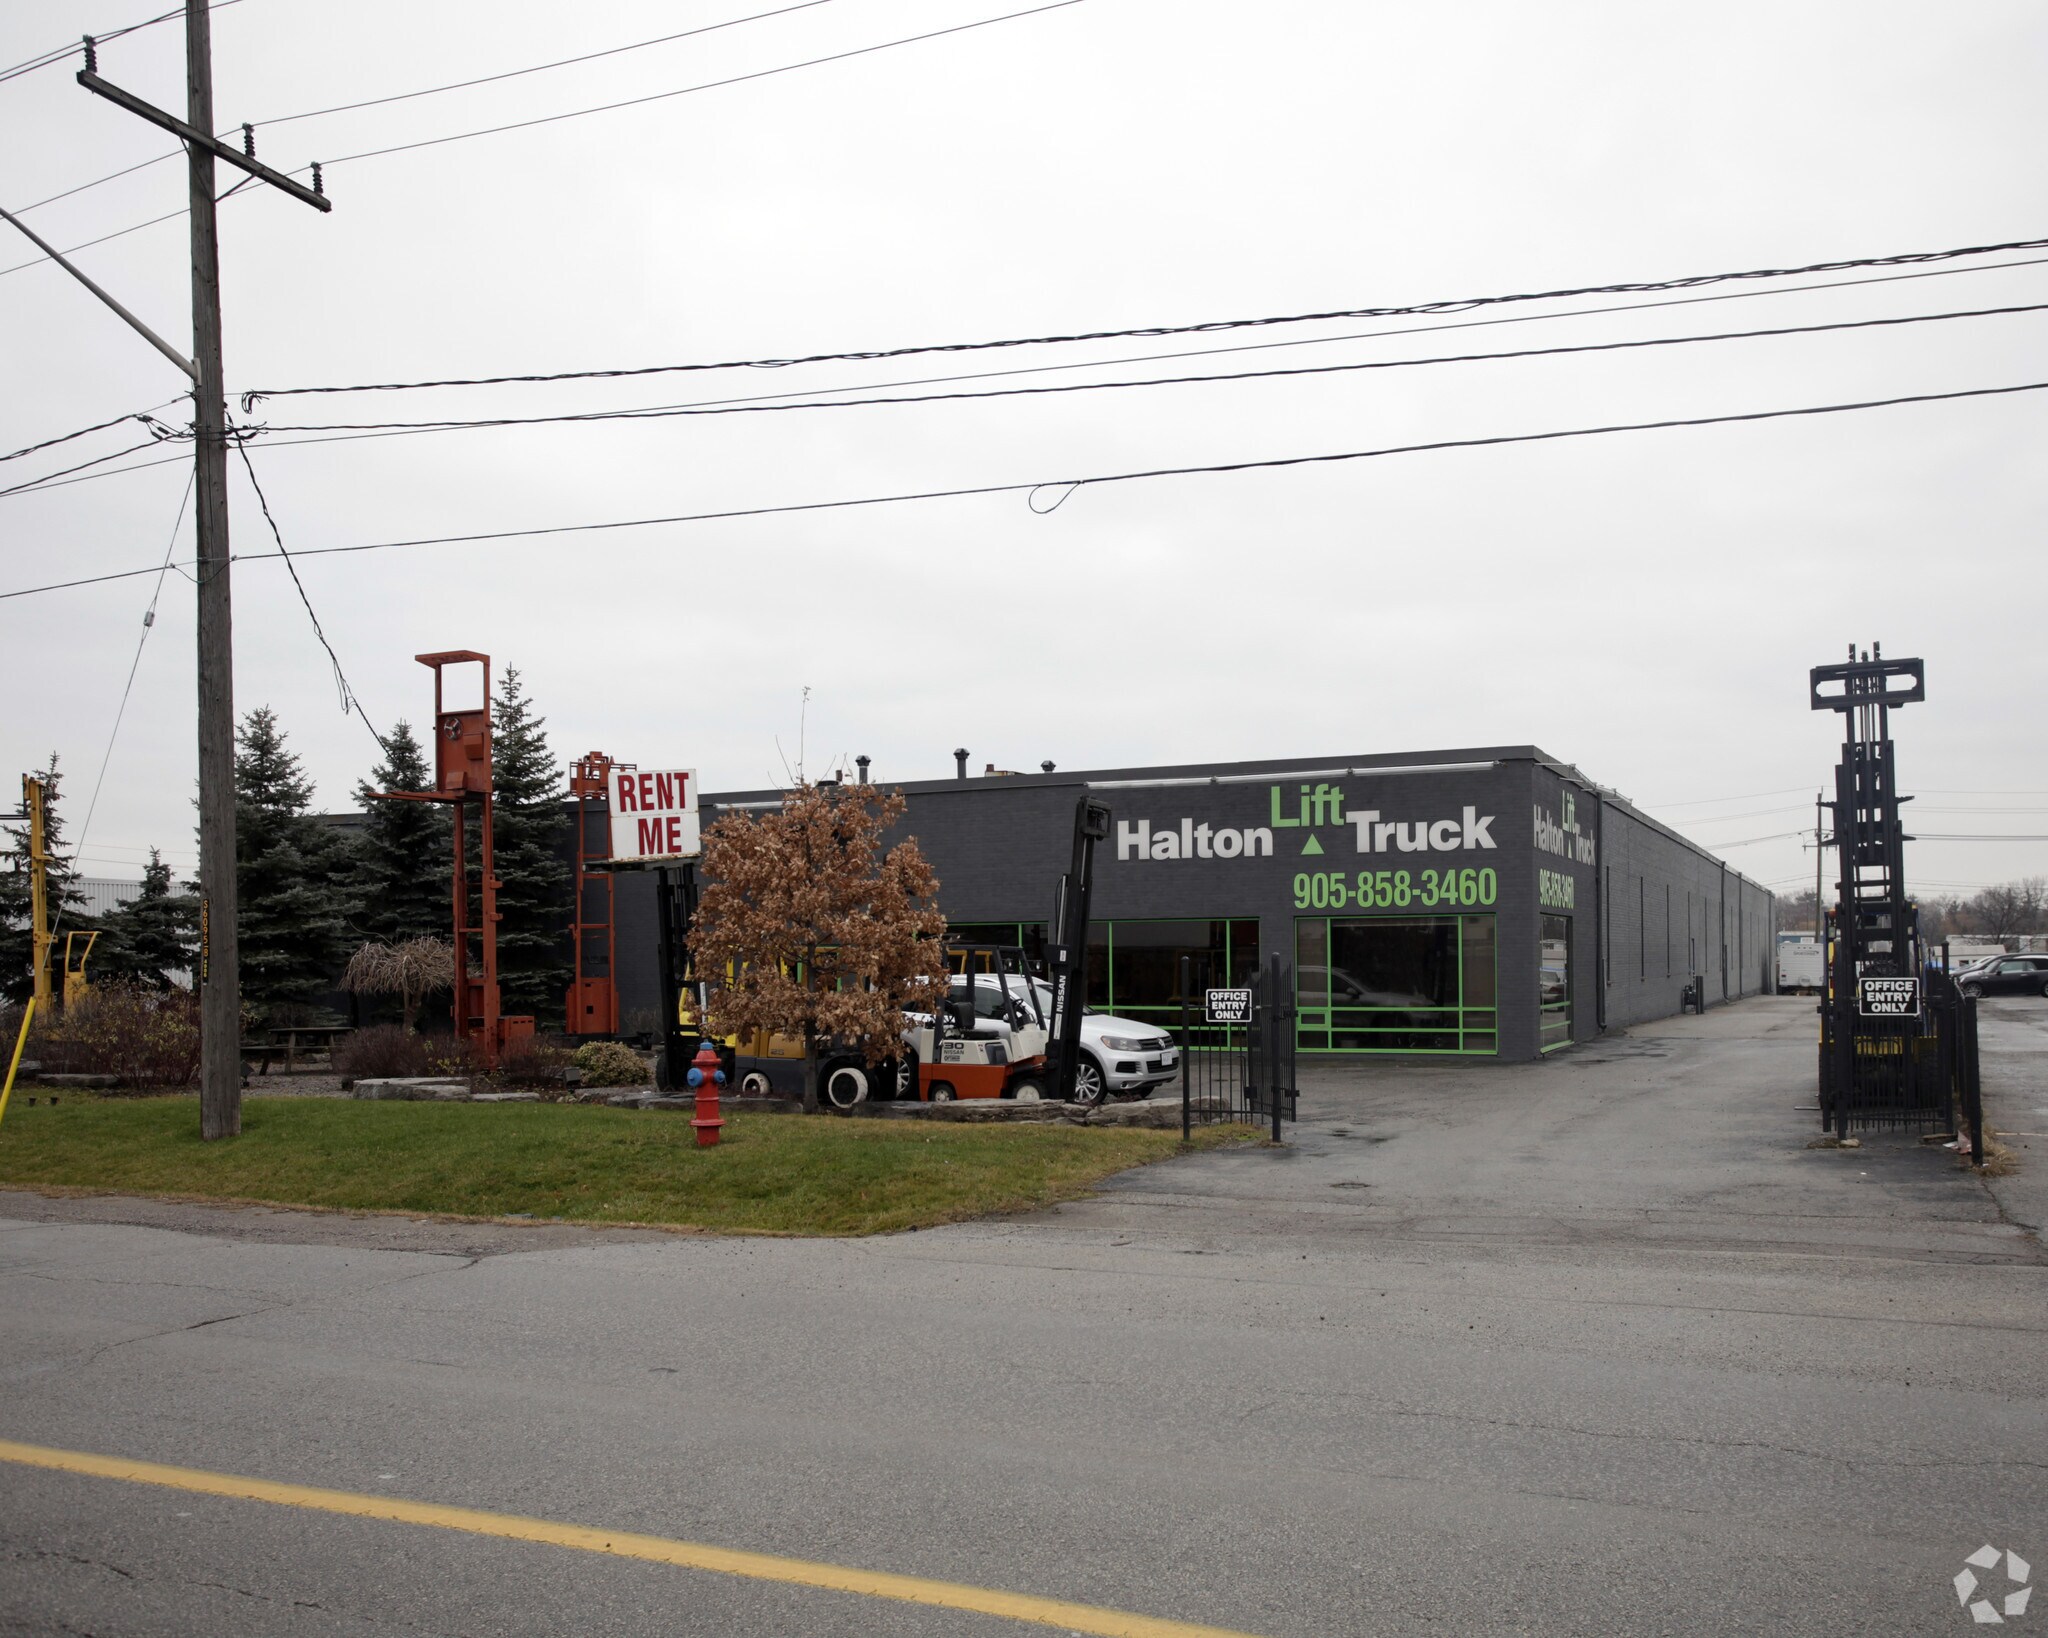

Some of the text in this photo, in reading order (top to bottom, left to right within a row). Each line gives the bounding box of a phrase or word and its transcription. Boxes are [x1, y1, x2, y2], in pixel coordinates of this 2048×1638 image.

[617, 772, 689, 812] RENT
[1117, 783, 1497, 860] Halton Lift Truck
[1534, 790, 1595, 866] Halton Lift Truck
[638, 816, 682, 855] ME
[1293, 867, 1497, 909] 905-858-3460
[1864, 981, 1914, 991] OFFICE
[1056, 975, 1067, 1013] NISSAN
[1210, 991, 1248, 1001] OFFICE
[1866, 992, 1912, 1002] ENTRY
[1211, 1001, 1247, 1010] ENTRY
[1871, 1002, 1907, 1013] ONLY
[1215, 1010, 1243, 1019] ONLY
[944, 1042, 965, 1050] 30
